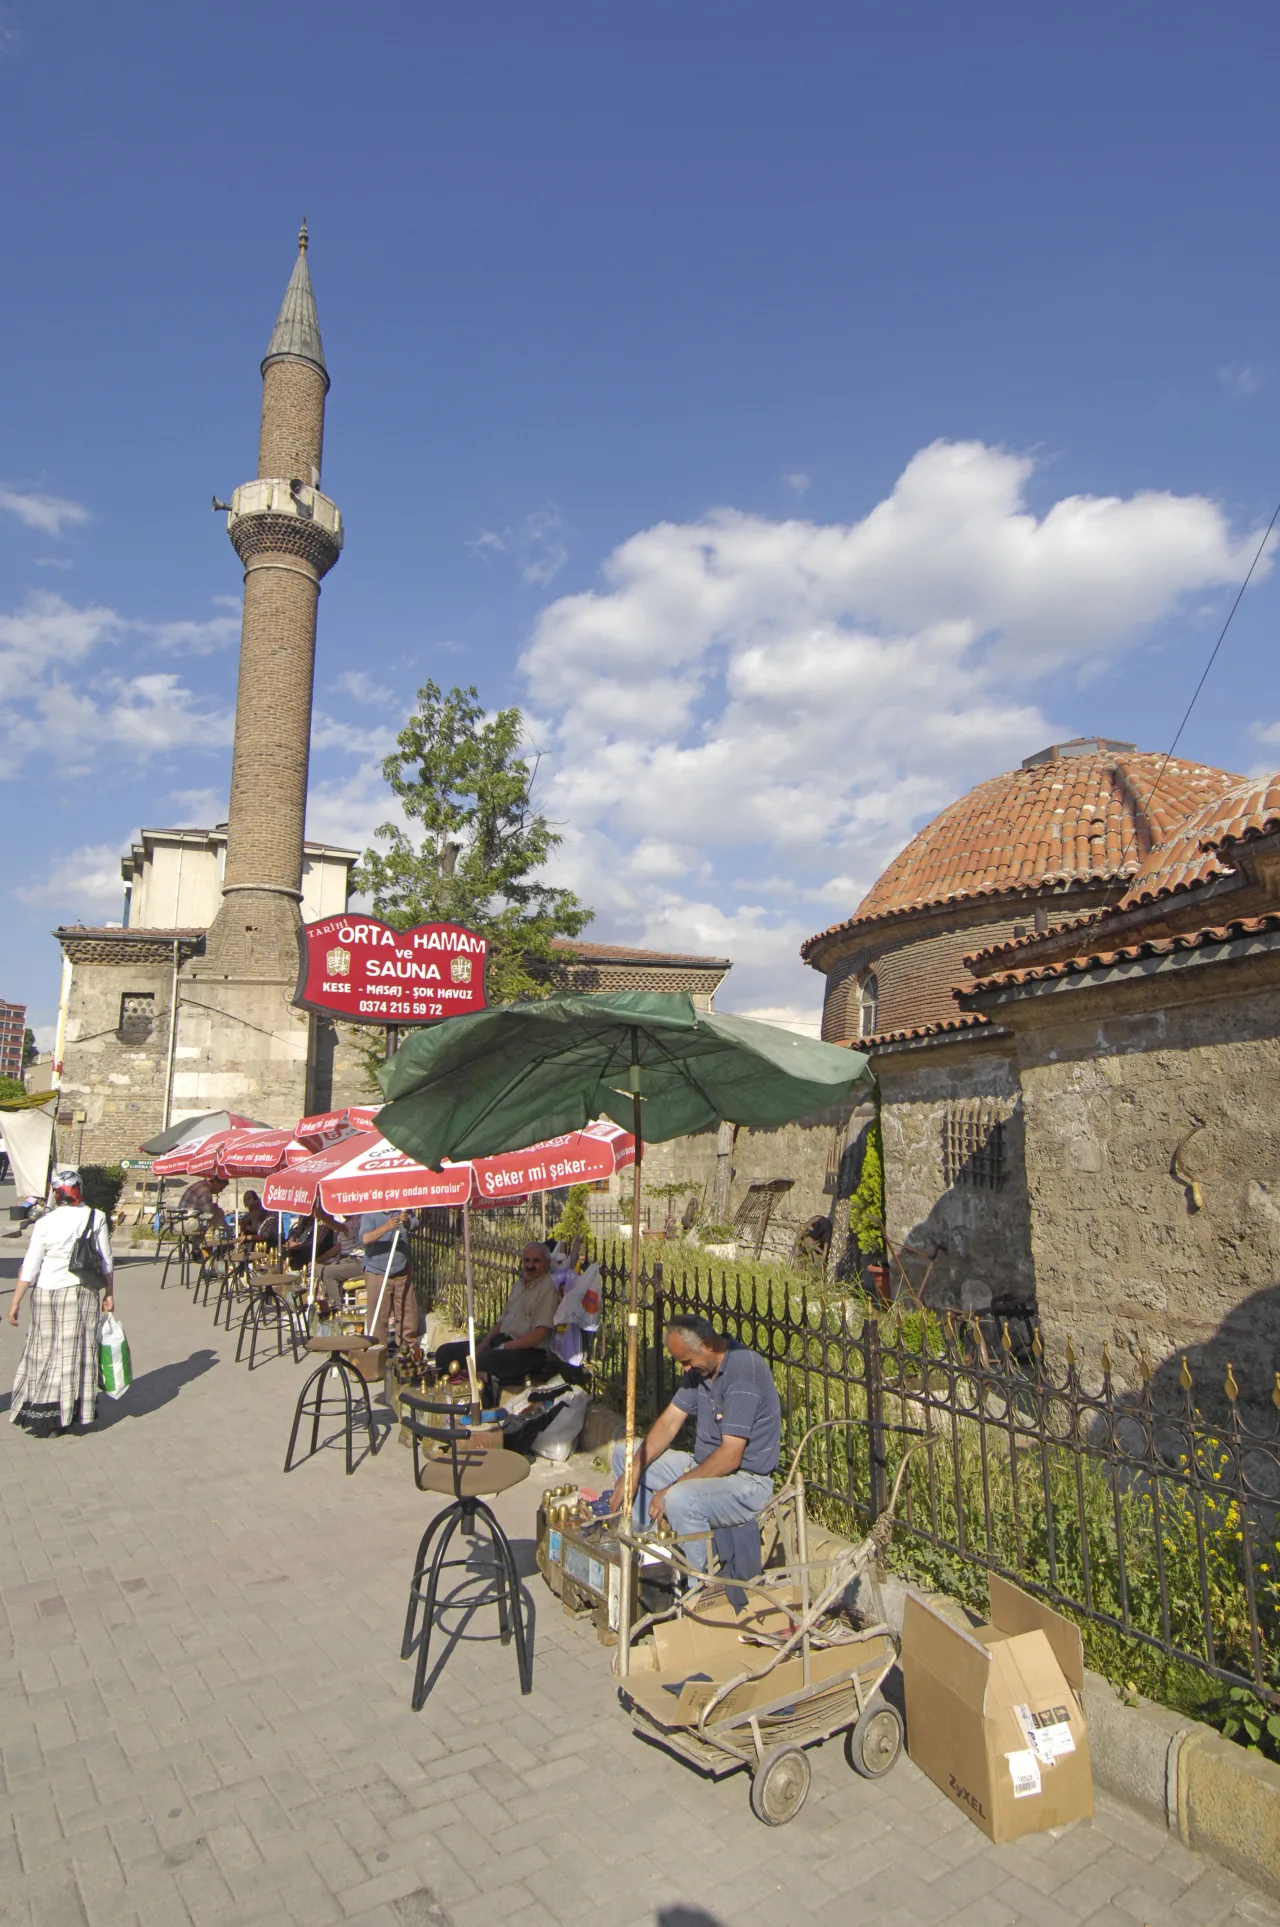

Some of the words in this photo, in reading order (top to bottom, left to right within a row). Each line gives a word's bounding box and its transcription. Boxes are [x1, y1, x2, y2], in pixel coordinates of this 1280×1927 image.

[307, 918, 349, 938] TARİHİ
[338, 924, 395, 946] ORTA
[414, 932, 486, 954] HAMAM
[395, 949, 413, 959] ve
[365, 960, 441, 980] SAUNA
[322, 982, 352, 993] KESE
[366, 985, 402, 997] MASAJ
[412, 987, 434, 999] ŞOK
[437, 989, 473, 999] HAVUZ
[359, 1000, 387, 1013] 0374
[390, 1002, 410, 1013] 215
[412, 1003, 427, 1014] 59
[429, 1004, 443, 1015] 72
[485, 1165, 524, 1193] Şeker
[528, 1162, 547, 1181] mi
[385, 1188, 400, 1200] çay
[402, 1185, 428, 1197] ondan
[949, 1772, 986, 1820] ZyXEL
